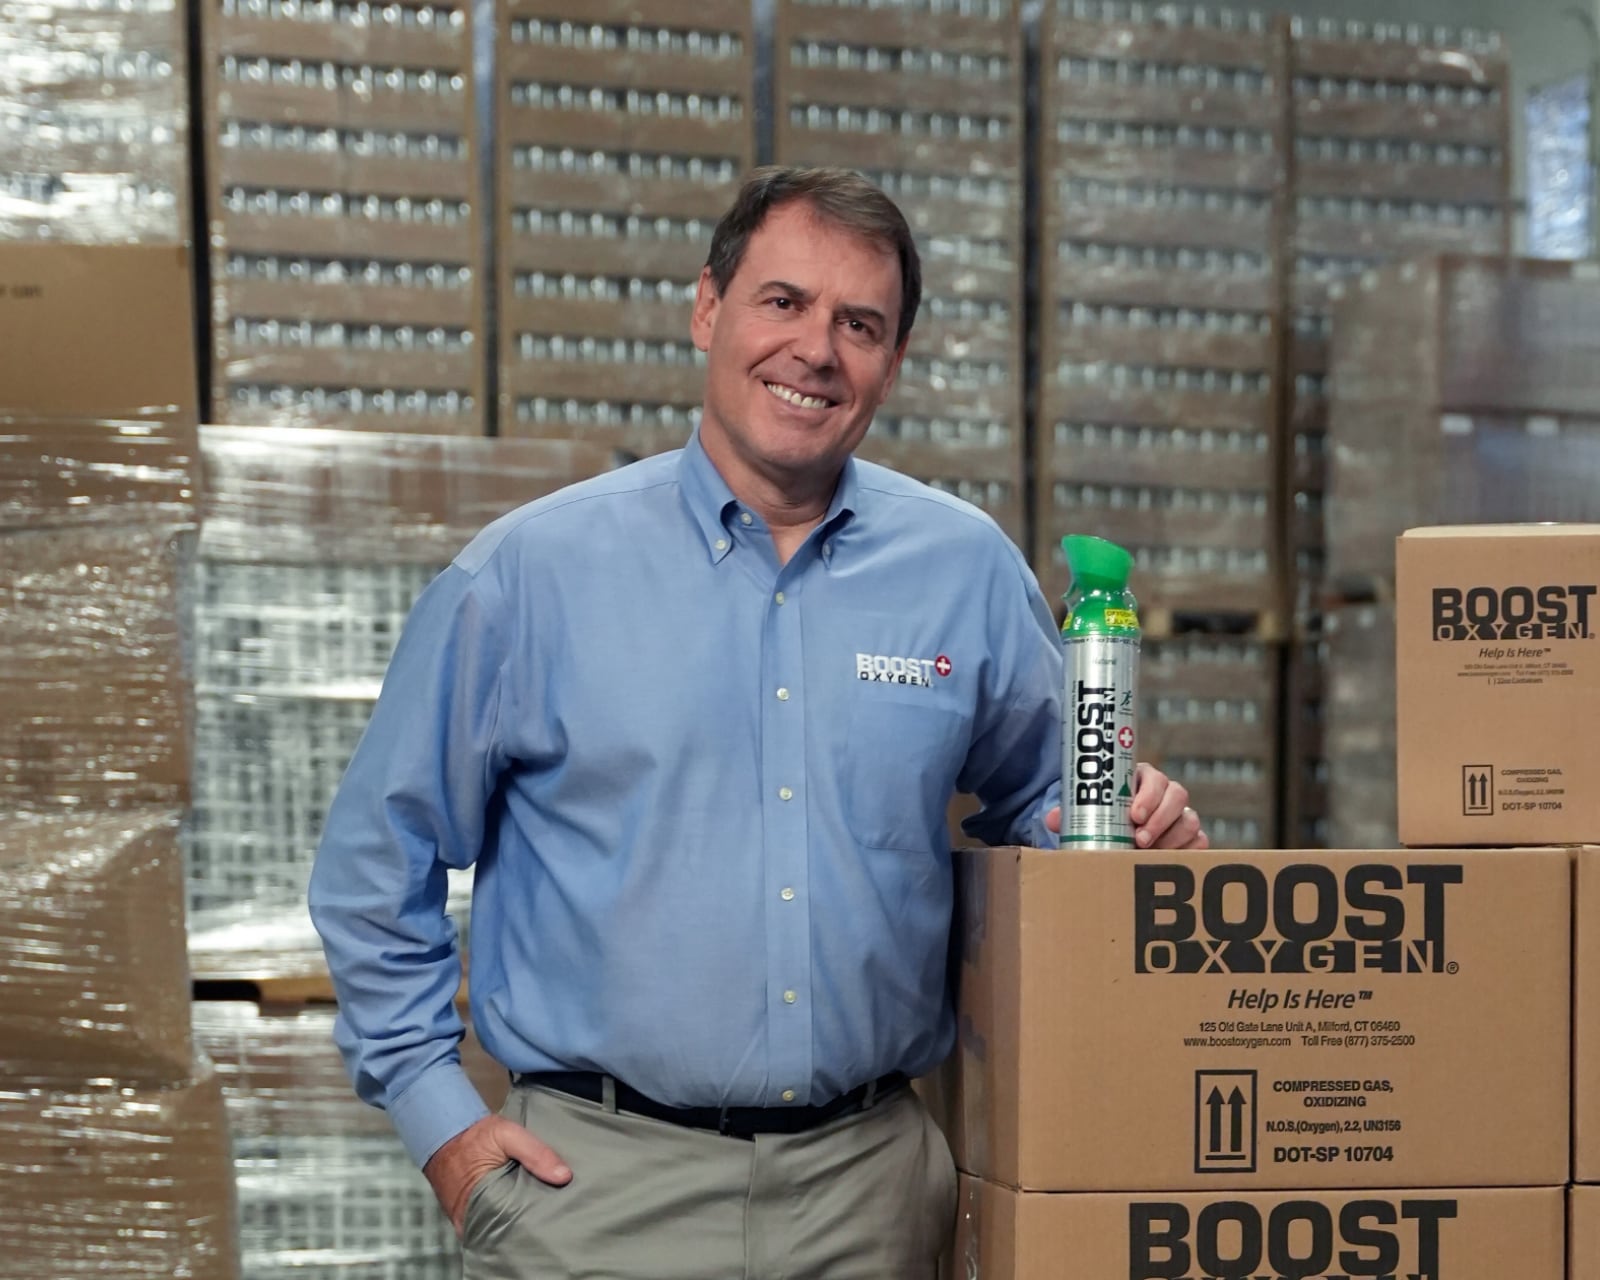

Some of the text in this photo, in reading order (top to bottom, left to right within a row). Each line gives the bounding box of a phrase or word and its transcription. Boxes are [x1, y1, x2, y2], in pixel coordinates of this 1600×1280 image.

[1433, 586, 1597, 626] BOOST
[1479, 648, 1504, 660] Help
[1506, 648, 1515, 658] Is
[856, 653, 935, 680] BOOST
[859, 671, 931, 688] OXYGEN
[1077, 680, 1104, 806] BOOST
[1102, 686, 1115, 806] OXYGEN
[1134, 863, 1463, 945] BOOST
[1228, 988, 1279, 1013] Help
[1283, 989, 1301, 1009] Is
[1199, 1021, 1217, 1032] 125
[1218, 1021, 1235, 1032] Old
[1236, 1021, 1260, 1032] Gate
[1261, 1021, 1284, 1032] Lane
[1285, 1021, 1304, 1032] Unit
[1354, 1021, 1369, 1032] CT
[1183, 1036, 1292, 1049] www.boostoxygen.com
[1301, 1035, 1415, 1048] Toll Free (877) 375-2500
[1273, 1080, 1394, 1093] COMPRESSED GAS,
[1303, 1096, 1366, 1107] OXIDIZING
[1273, 1146, 1394, 1162] DOT-SP 10704
[1129, 1199, 1458, 1278] BOOST
